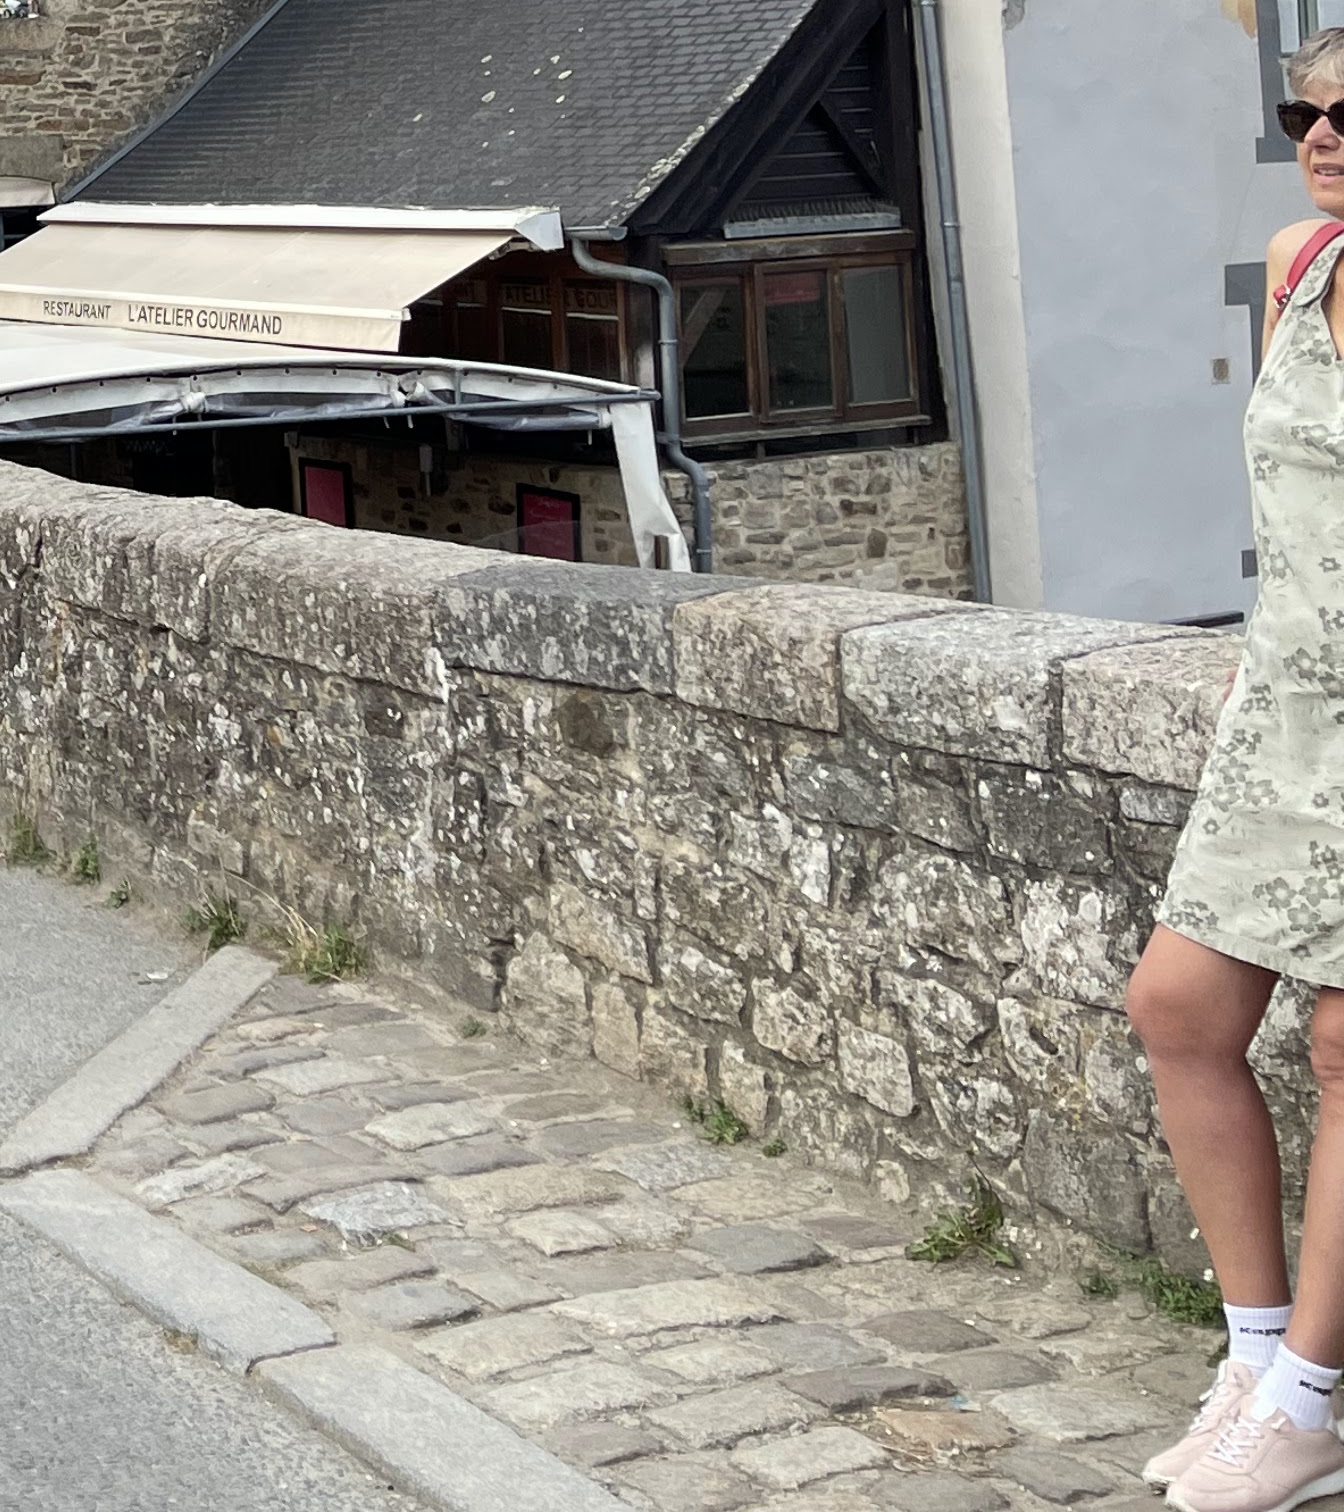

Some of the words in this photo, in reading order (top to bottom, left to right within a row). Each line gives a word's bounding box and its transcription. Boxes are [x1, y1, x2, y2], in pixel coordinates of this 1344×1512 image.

[43, 300, 112, 320] RESTAURANT
[128, 303, 193, 328] L'ATELIER
[196, 309, 282, 335] GOURMAND
